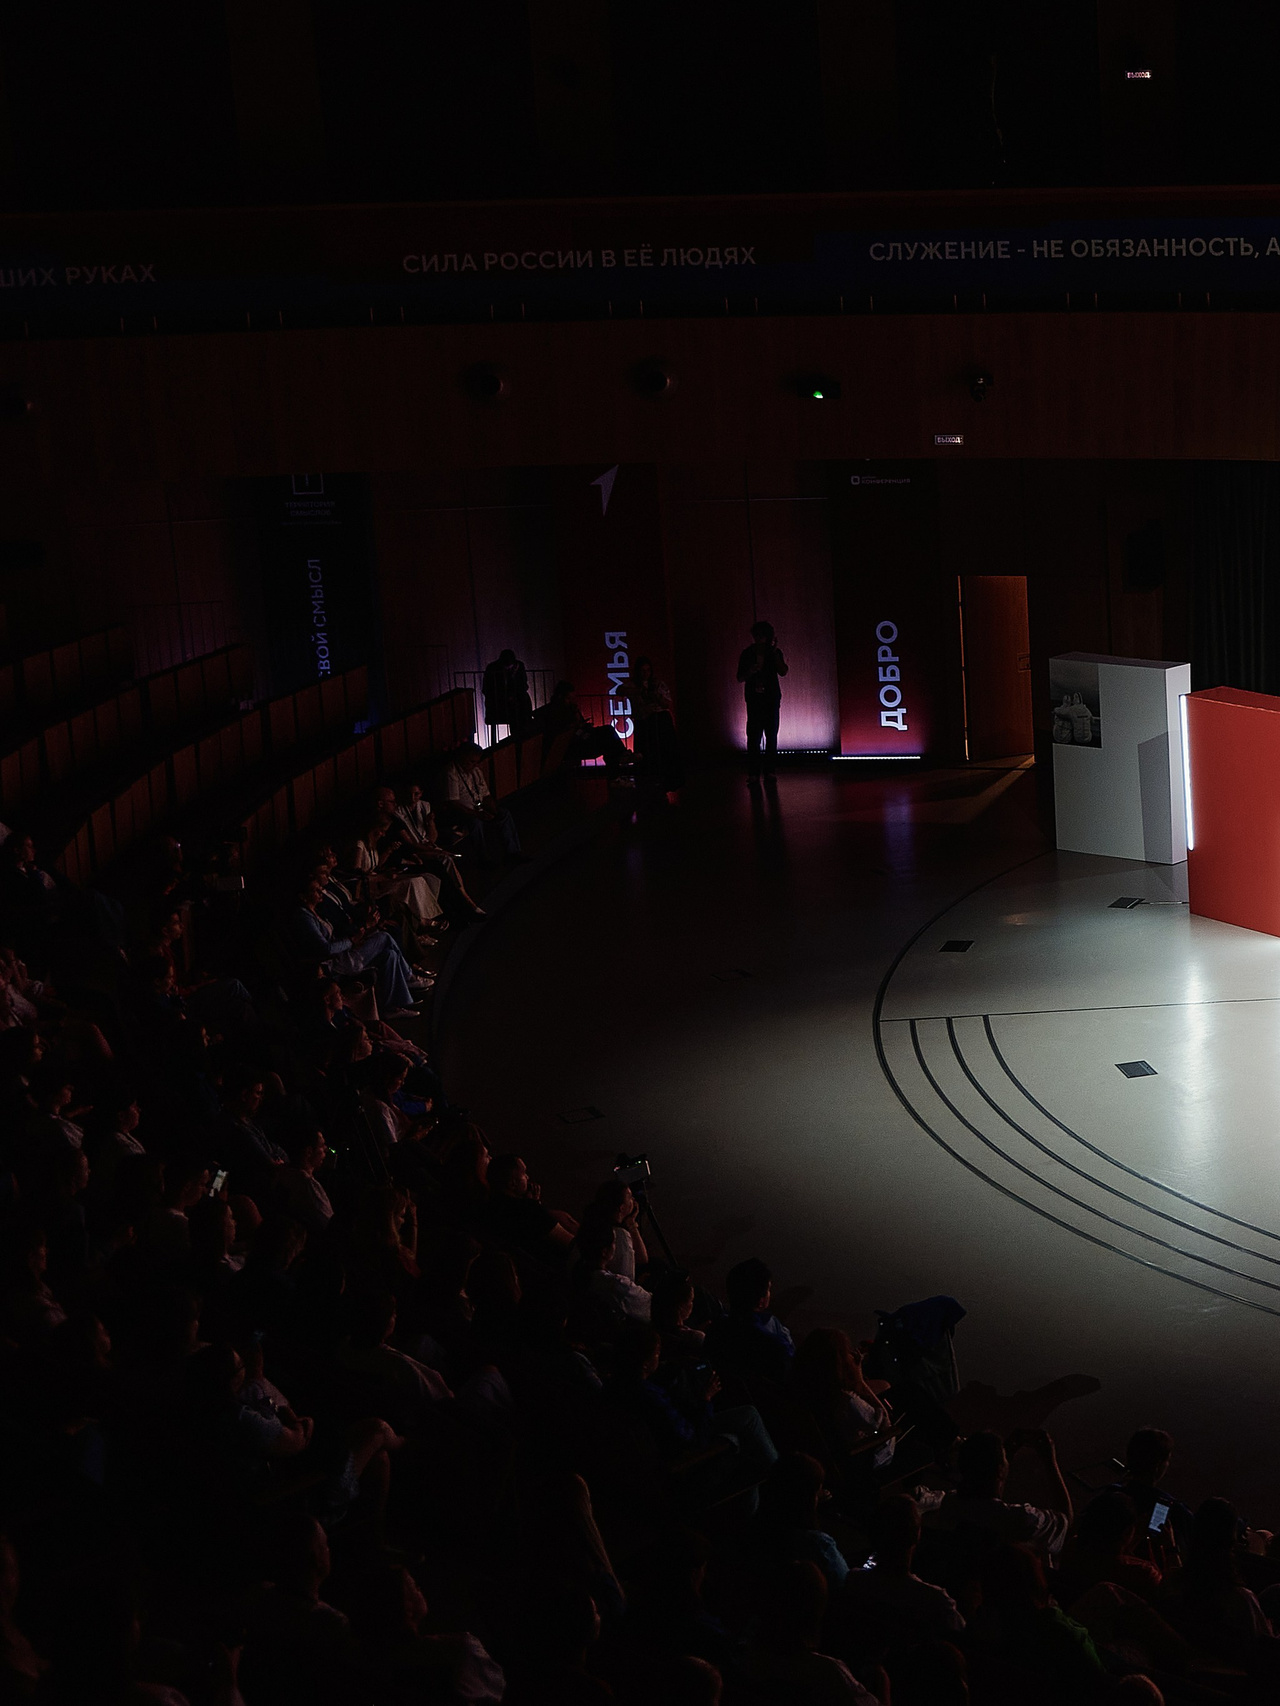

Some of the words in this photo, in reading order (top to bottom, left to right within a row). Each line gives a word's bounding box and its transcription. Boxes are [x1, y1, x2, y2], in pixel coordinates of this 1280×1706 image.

[64, 262, 158, 286] РУКАХ
[402, 253, 478, 274] СИЛА
[484, 250, 593, 272] РОССИИ
[602, 250, 617, 269] В
[623, 243, 654, 268] ЕЁ
[659, 246, 757, 270] ЛЮДЯХ
[869, 241, 1011, 261] СЛУЖЕНИЕ
[1032, 239, 1064, 259] НЕ
[1070, 237, 1260, 260] ОБЯЗАННОСТЬ,
[307, 559, 327, 628] СМЫСЛ
[604, 631, 635, 739] СЕМЬЯ
[875, 620, 908, 731] ДОБРО
